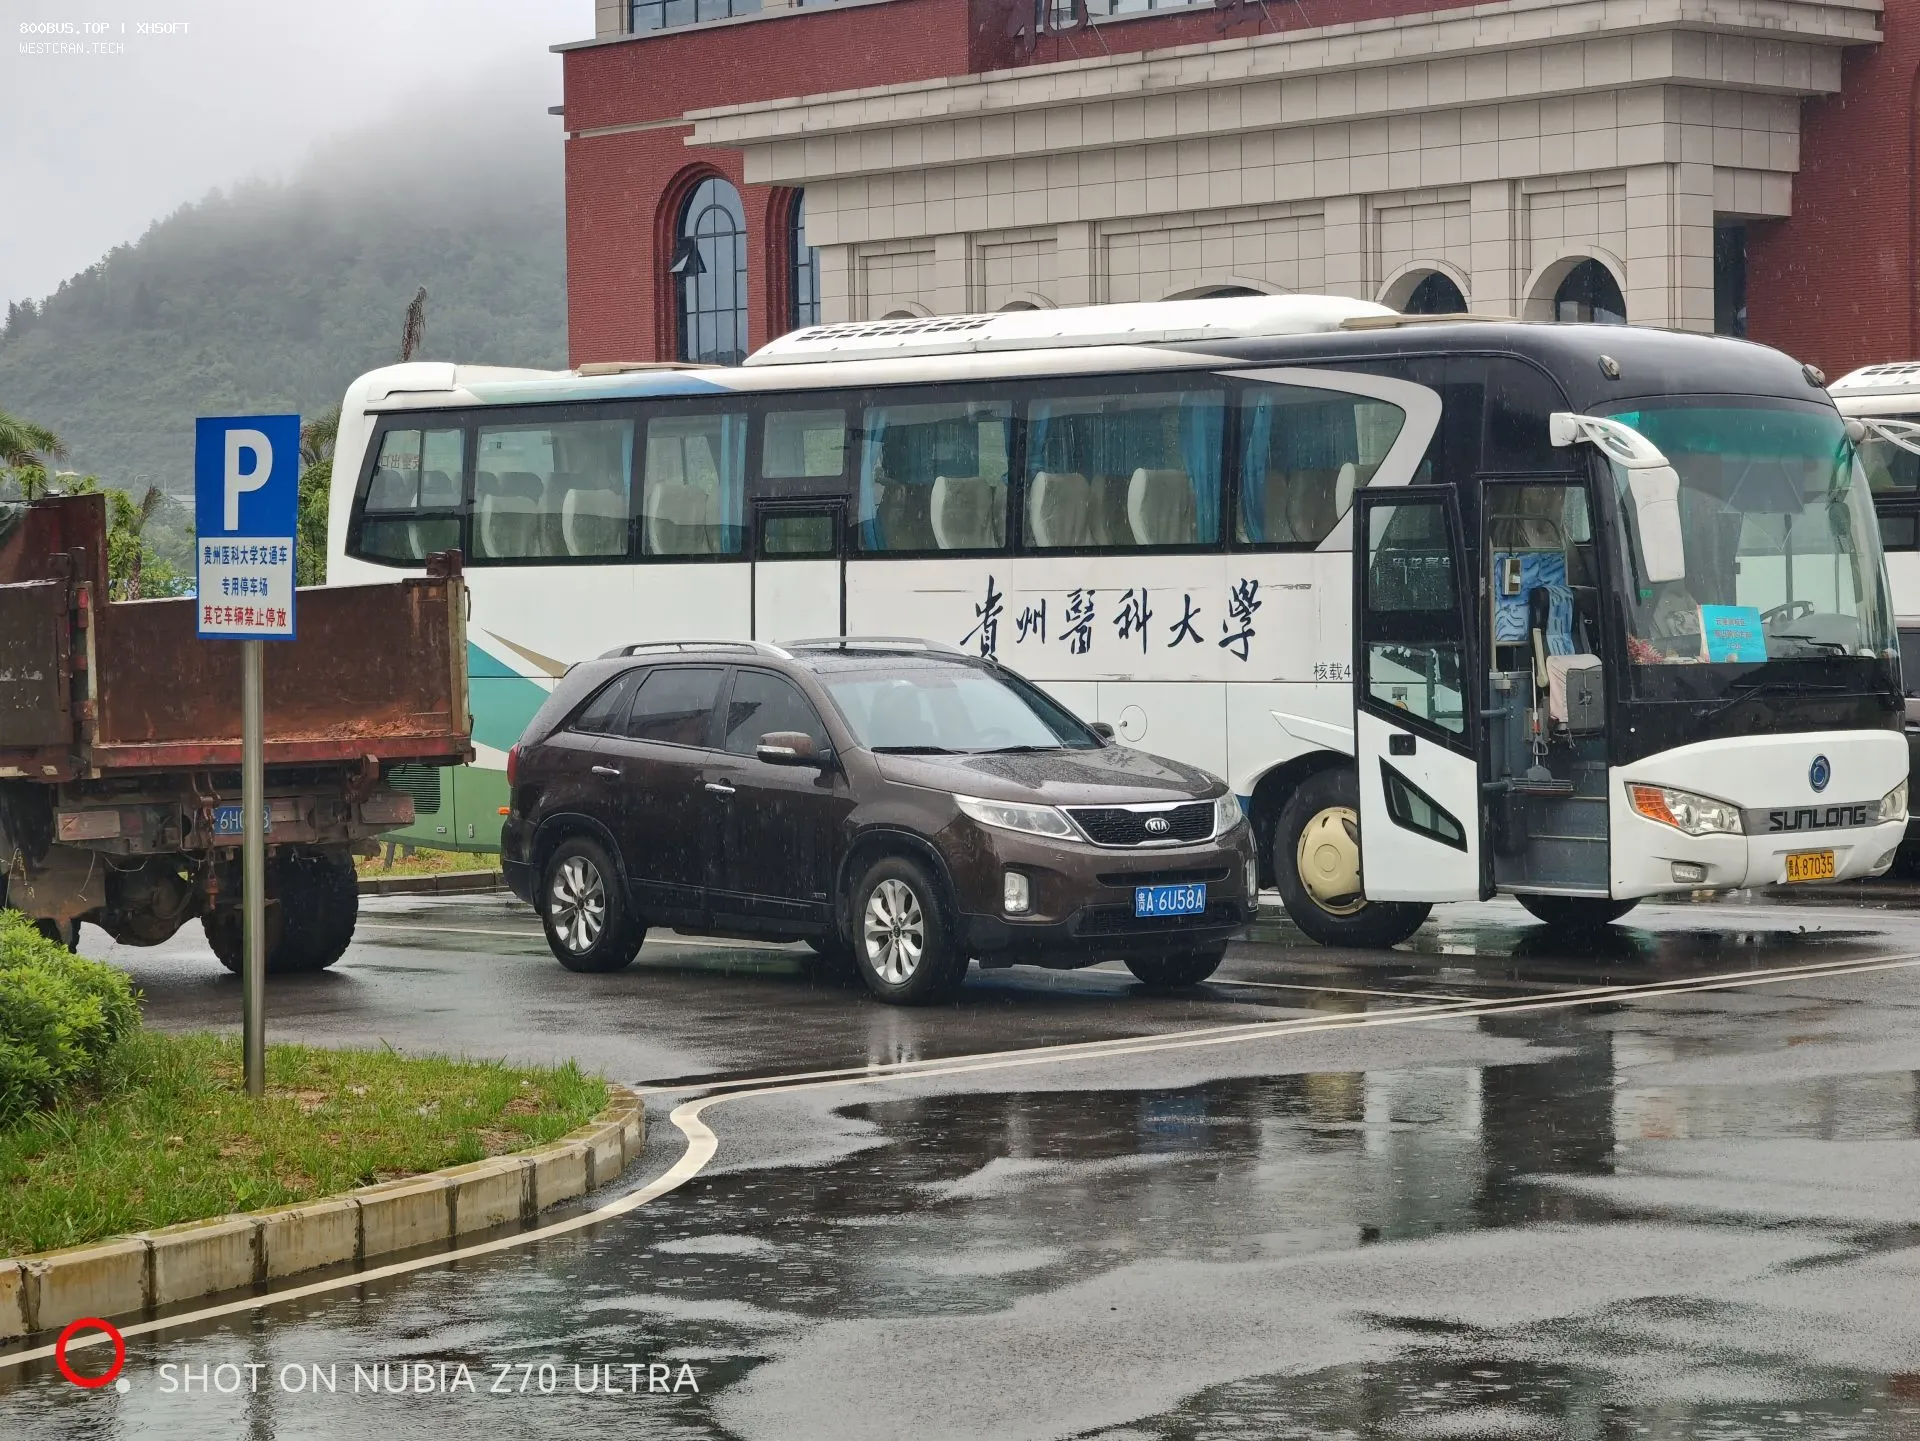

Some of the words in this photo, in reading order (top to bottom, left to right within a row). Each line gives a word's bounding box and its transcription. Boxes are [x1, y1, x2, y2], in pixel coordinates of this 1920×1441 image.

[224, 429, 273, 530] P
[203, 545, 288, 566] 贵州医科大学交通车
[221, 576, 268, 597] 专用停车场
[203, 604, 287, 628] 其它车辆禁止停放
[1149, 820, 1167, 831] KIA
[1769, 805, 1867, 832] SUNLONG
